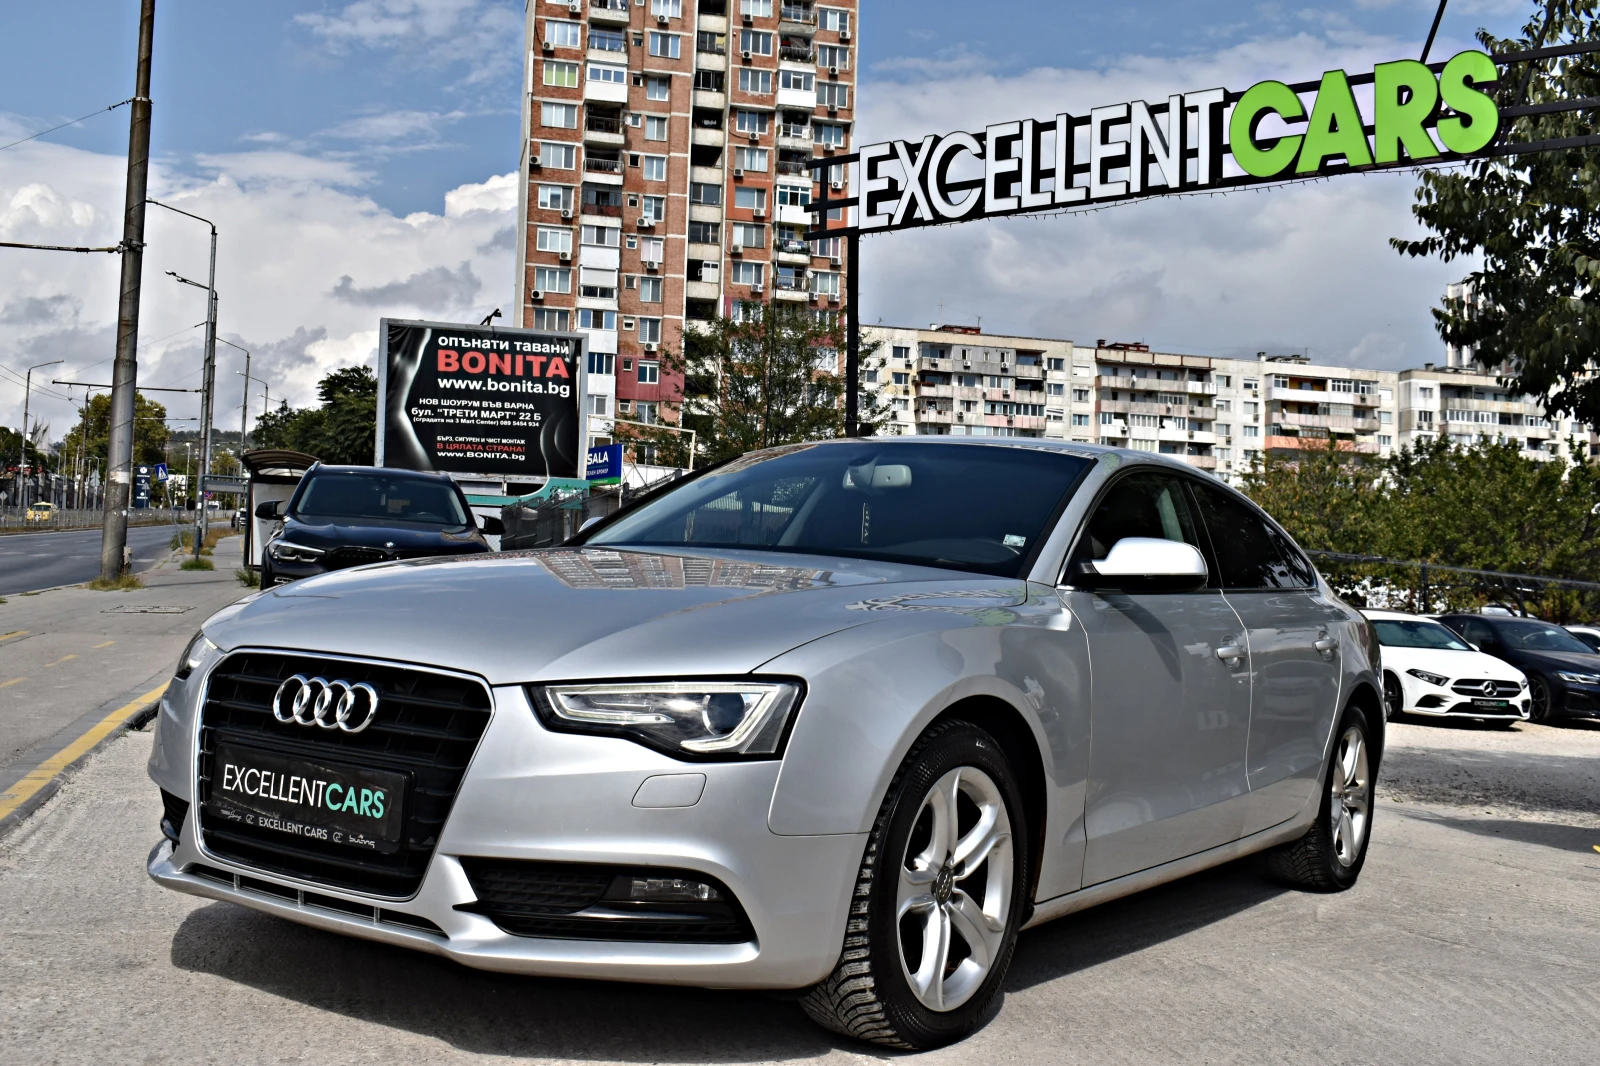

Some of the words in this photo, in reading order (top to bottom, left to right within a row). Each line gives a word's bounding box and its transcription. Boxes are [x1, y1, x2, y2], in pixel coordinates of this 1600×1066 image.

[438, 336, 509, 350] опънати
[514, 341, 569, 354] тавани
[437, 349, 570, 378] BONITA
[437, 378, 570, 398] www.bonita.bg
[441, 399, 480, 407] ШОУРУМ
[504, 402, 535, 410] ВАРНА
[411, 407, 434, 416] бул.
[518, 412, 531, 420] 22
[533, 413, 542, 421] Б
[436, 451, 526, 461] www.BONITA.bg
[446, 443, 483, 451] ЦЯЛАТА
[485, 444, 526, 453] СТРАНА!
[258, 816, 303, 834] EXCELLENT
[304, 826, 328, 840] CARS
